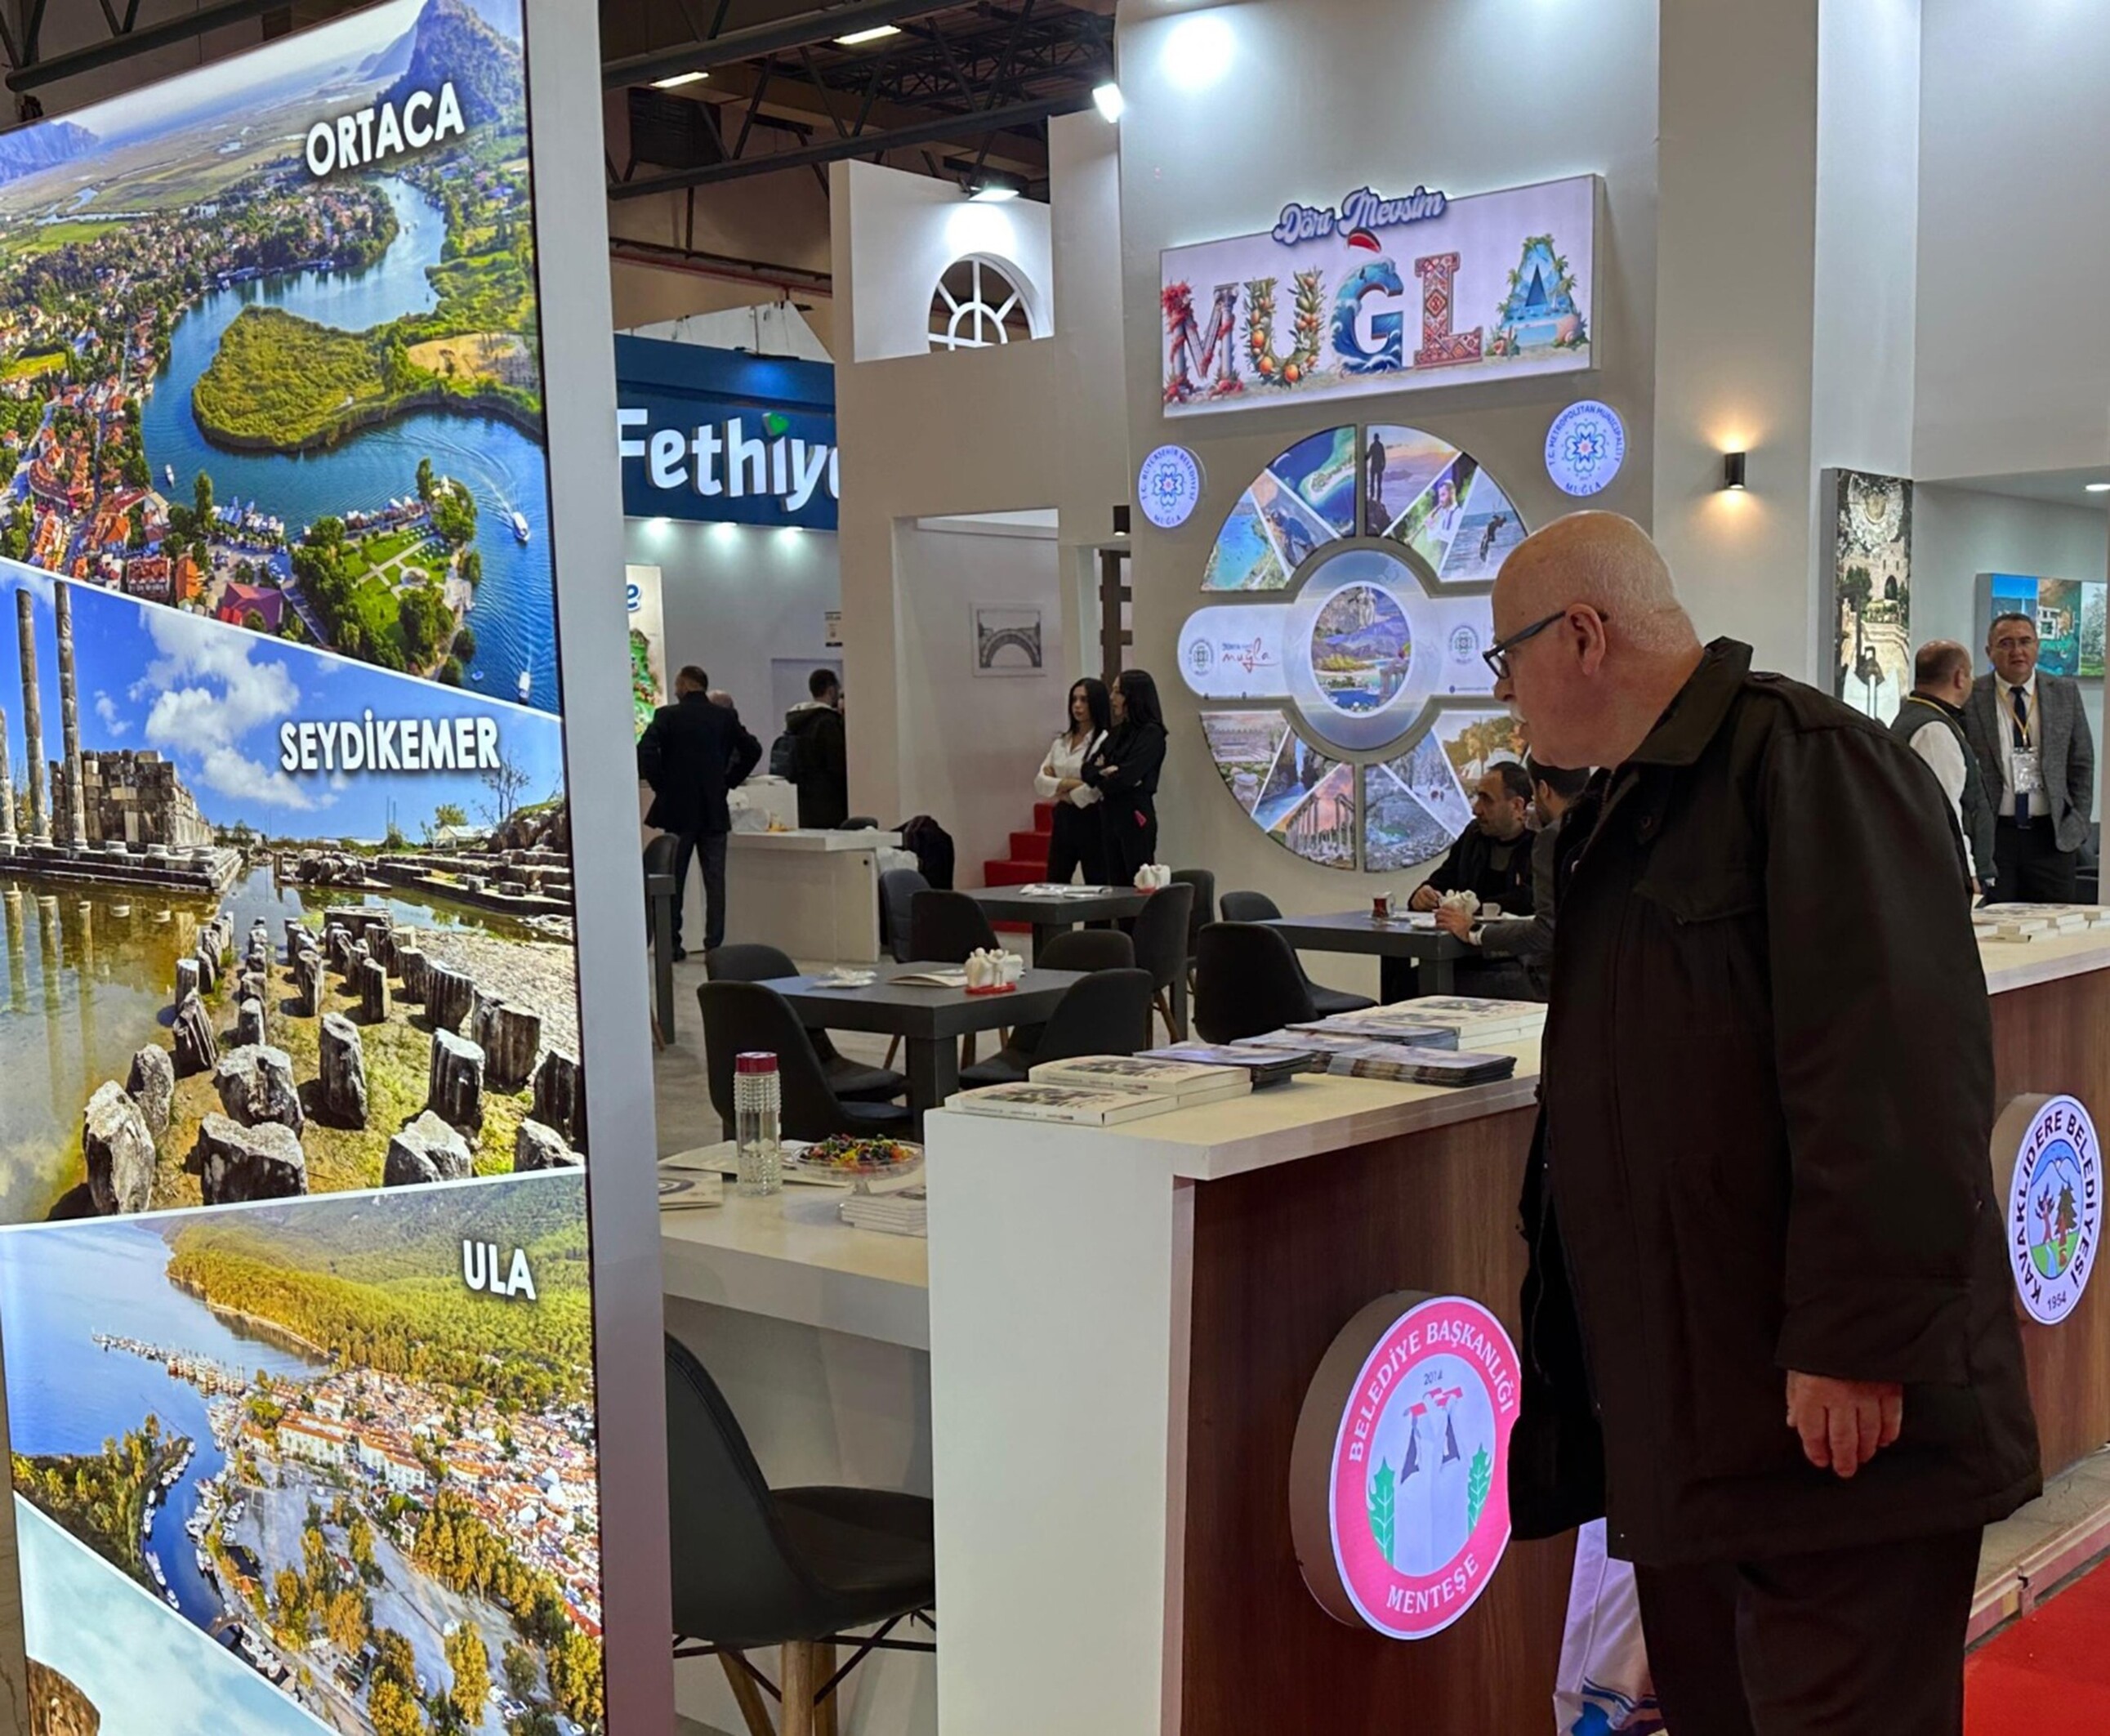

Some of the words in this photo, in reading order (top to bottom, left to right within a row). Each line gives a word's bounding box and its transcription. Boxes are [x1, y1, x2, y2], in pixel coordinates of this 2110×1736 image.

[306, 82, 466, 176] ORTACA
[1336, 187, 1447, 237] Mevsim
[617, 408, 838, 512] Fethiy
[280, 709, 501, 770] SEYDİKEMER
[2017, 1109, 2063, 1304] KAVAKLIDERE
[2065, 1113, 2095, 1288] BELEDİYESİ
[463, 1239, 536, 1301] ULA
[2047, 1291, 2067, 1311] 1954
[1349, 1330, 1422, 1462] BELEDİYE
[1426, 1319, 1515, 1414] BAŞKANLIĞI
[1386, 1553, 1479, 1614] MENTEŞE
